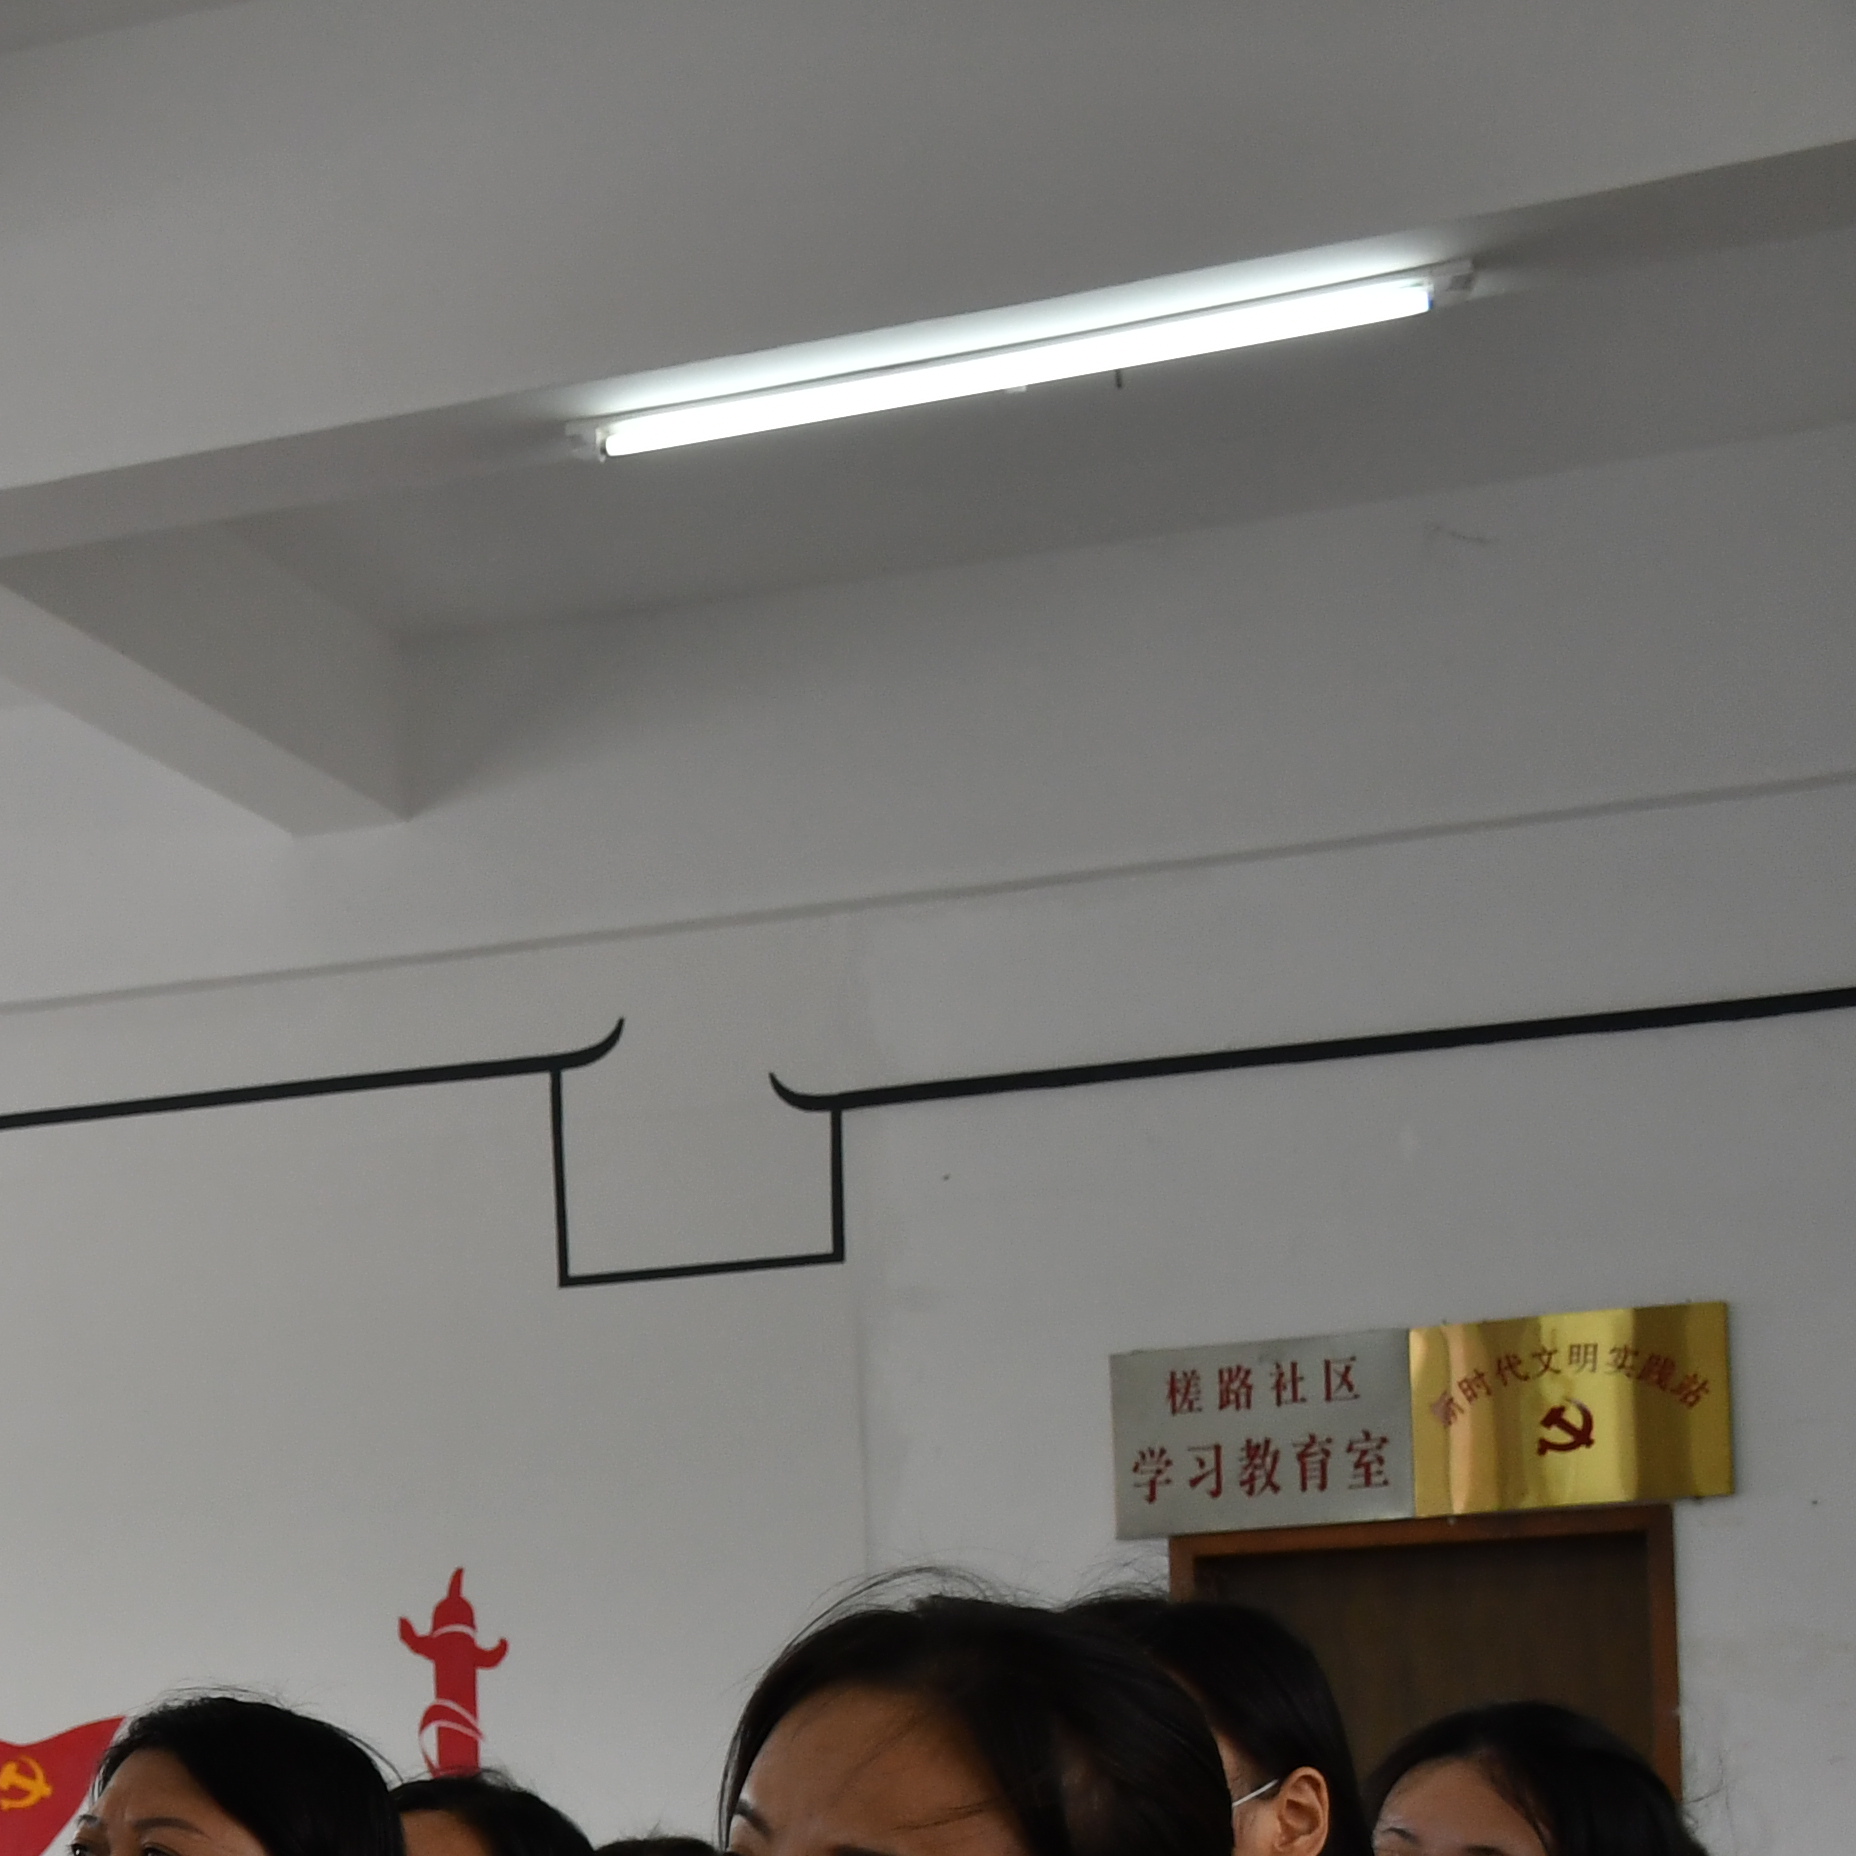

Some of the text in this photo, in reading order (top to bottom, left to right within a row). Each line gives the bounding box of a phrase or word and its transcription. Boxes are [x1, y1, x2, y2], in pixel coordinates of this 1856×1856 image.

[1432, 1342, 1712, 1428] 新时代文明实践站
[1131, 1430, 1390, 1504] 学习教育室
